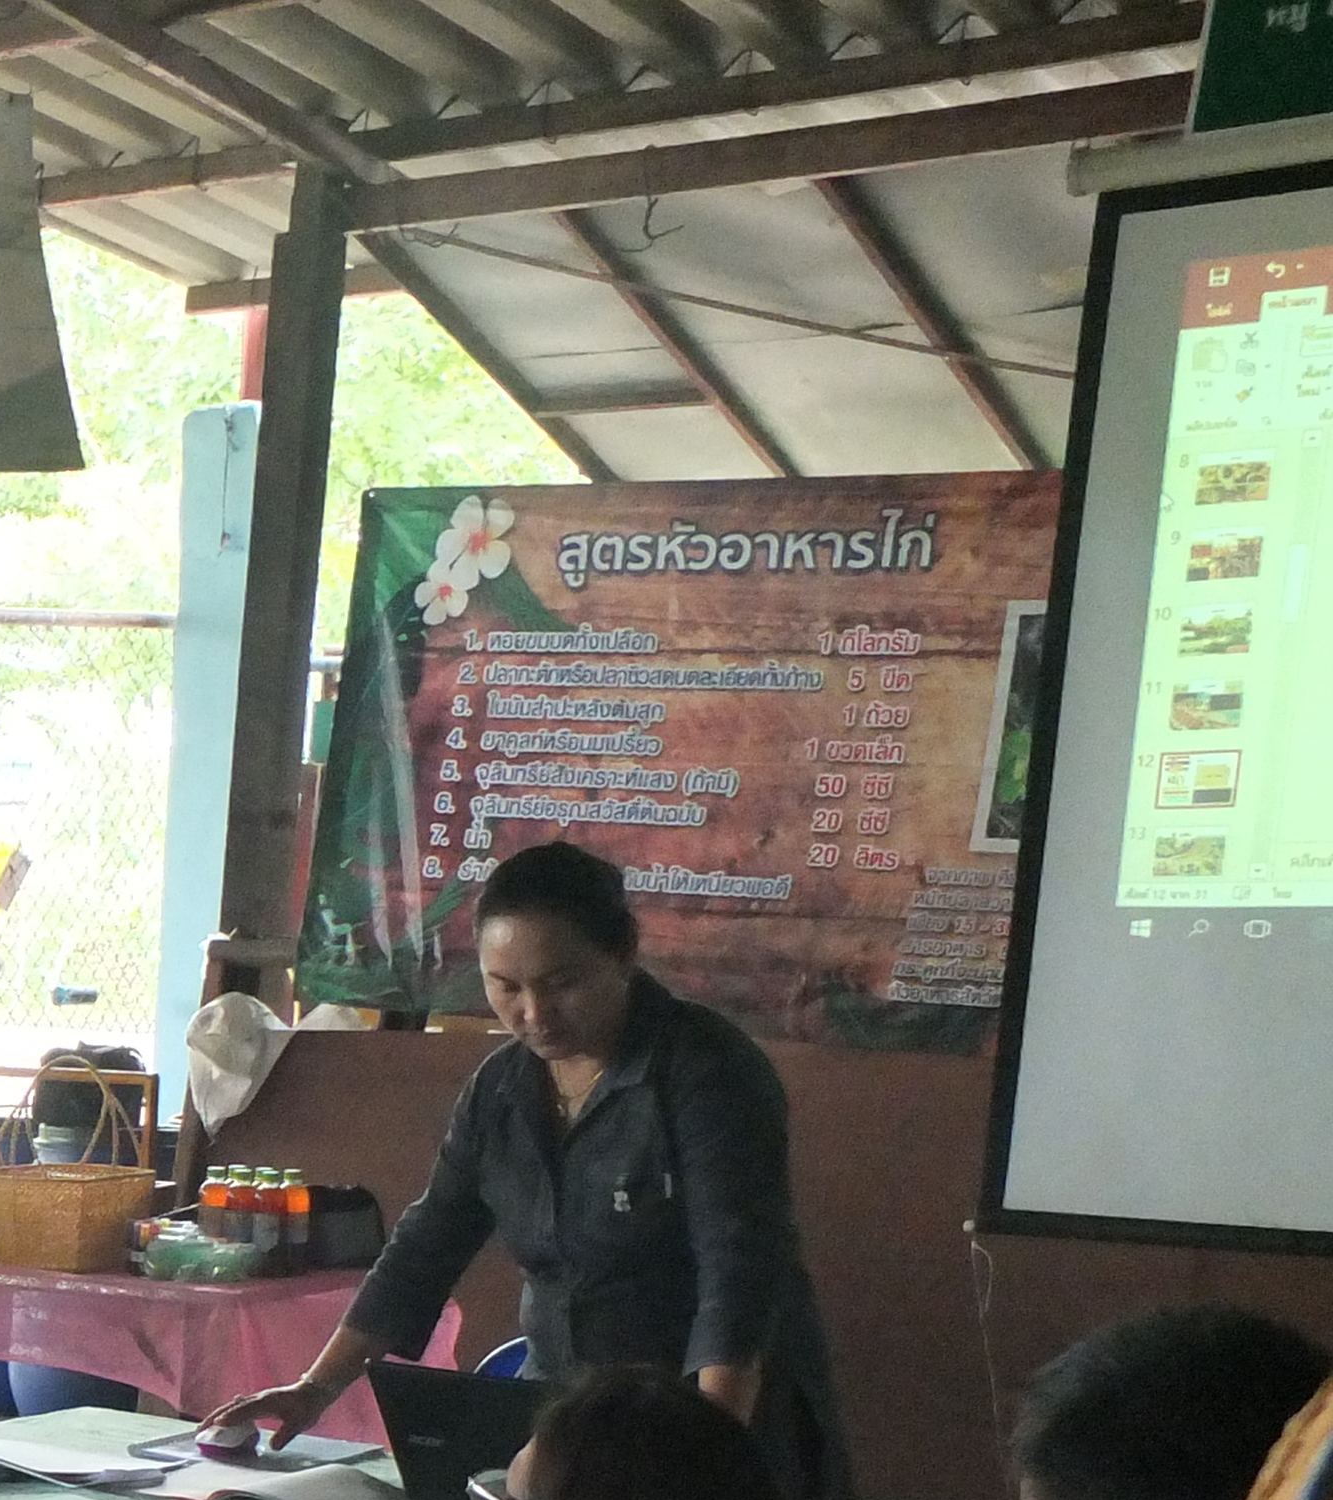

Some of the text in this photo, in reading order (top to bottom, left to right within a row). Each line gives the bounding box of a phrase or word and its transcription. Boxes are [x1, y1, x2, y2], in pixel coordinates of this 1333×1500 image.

[557, 508, 935, 588] สูตรหัวอาหารไก่
[464, 629, 483, 651] 1.
[819, 625, 921, 656] 1 กิโลกรัม
[457, 662, 477, 685] 2.
[847, 667, 865, 692] 5
[452, 694, 473, 717] 3.
[843, 699, 910, 728] 1 ถ้วย
[446, 727, 467, 750] 4.
[805, 736, 819, 760] 1
[440, 760, 462, 782] 5.
[815, 773, 846, 798] 50
[434, 792, 456, 814] 6.
[811, 809, 843, 833] 20
[429, 824, 450, 847] 7.
[423, 856, 444, 879] 8.
[807, 844, 900, 872] 20 ลิตร
